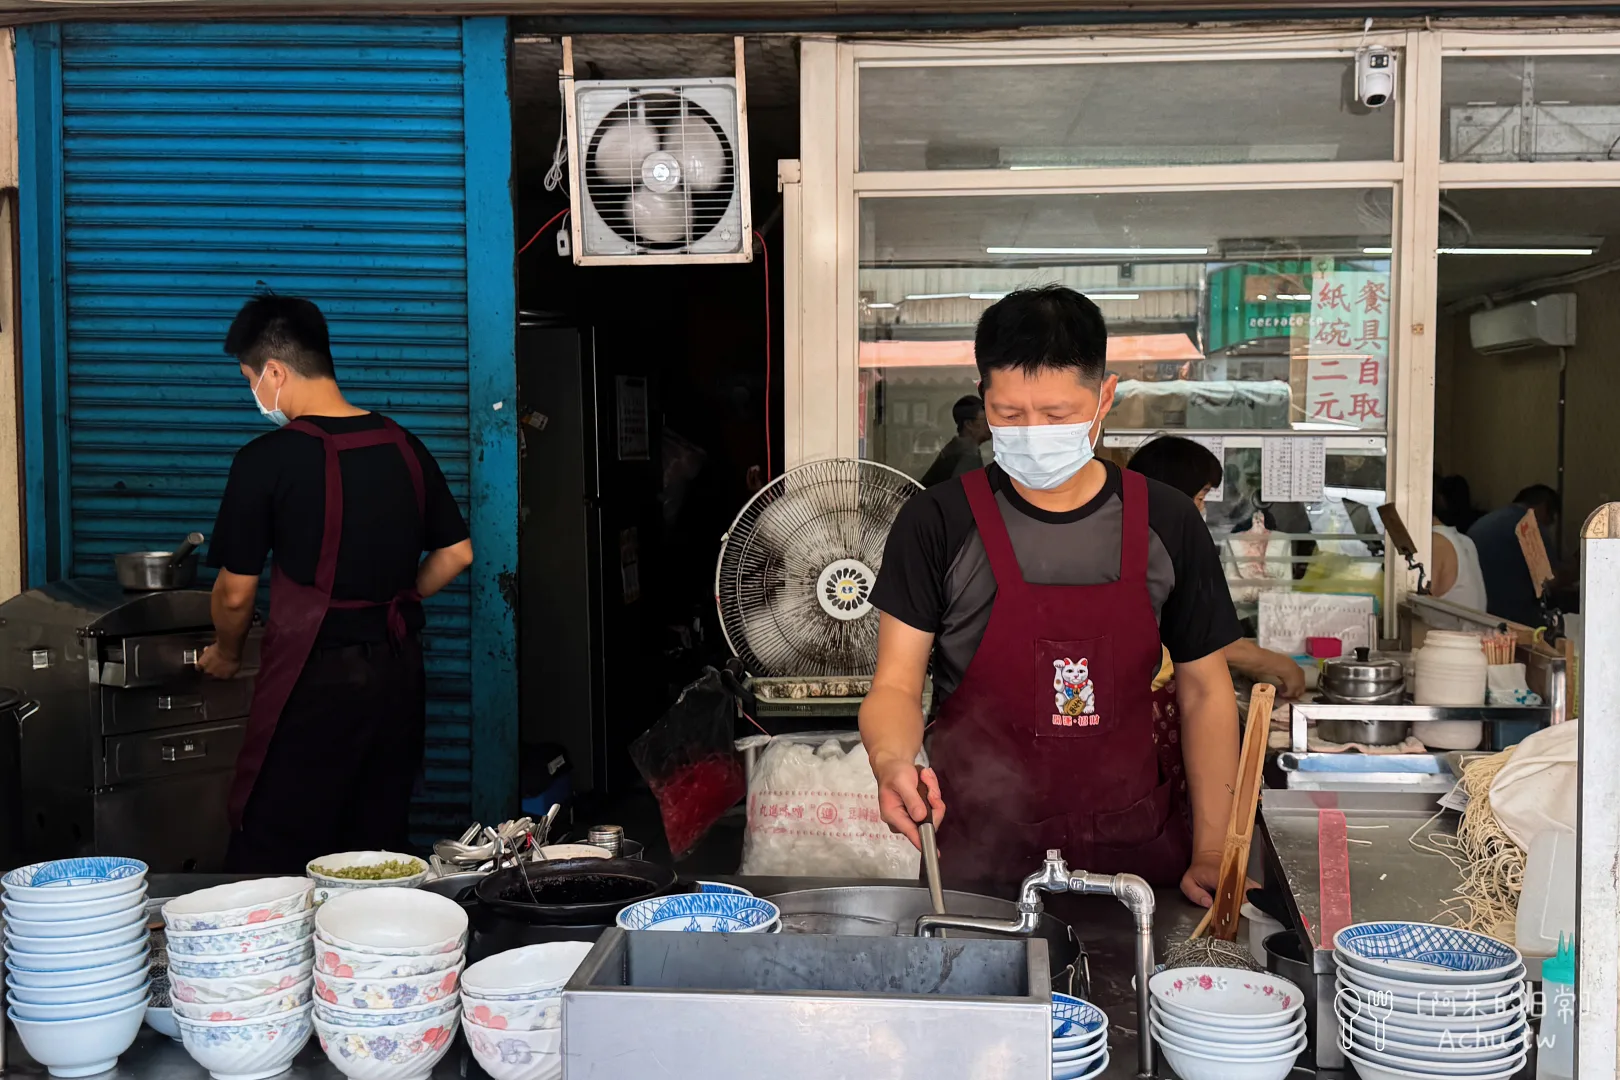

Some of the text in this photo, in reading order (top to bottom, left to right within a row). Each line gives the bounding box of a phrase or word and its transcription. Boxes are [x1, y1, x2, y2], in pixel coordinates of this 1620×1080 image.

[1310, 281, 1351, 421] 紙碗二元
[1350, 280, 1389, 422] 餐具自取
[1072, 880, 1084, 889] YF
